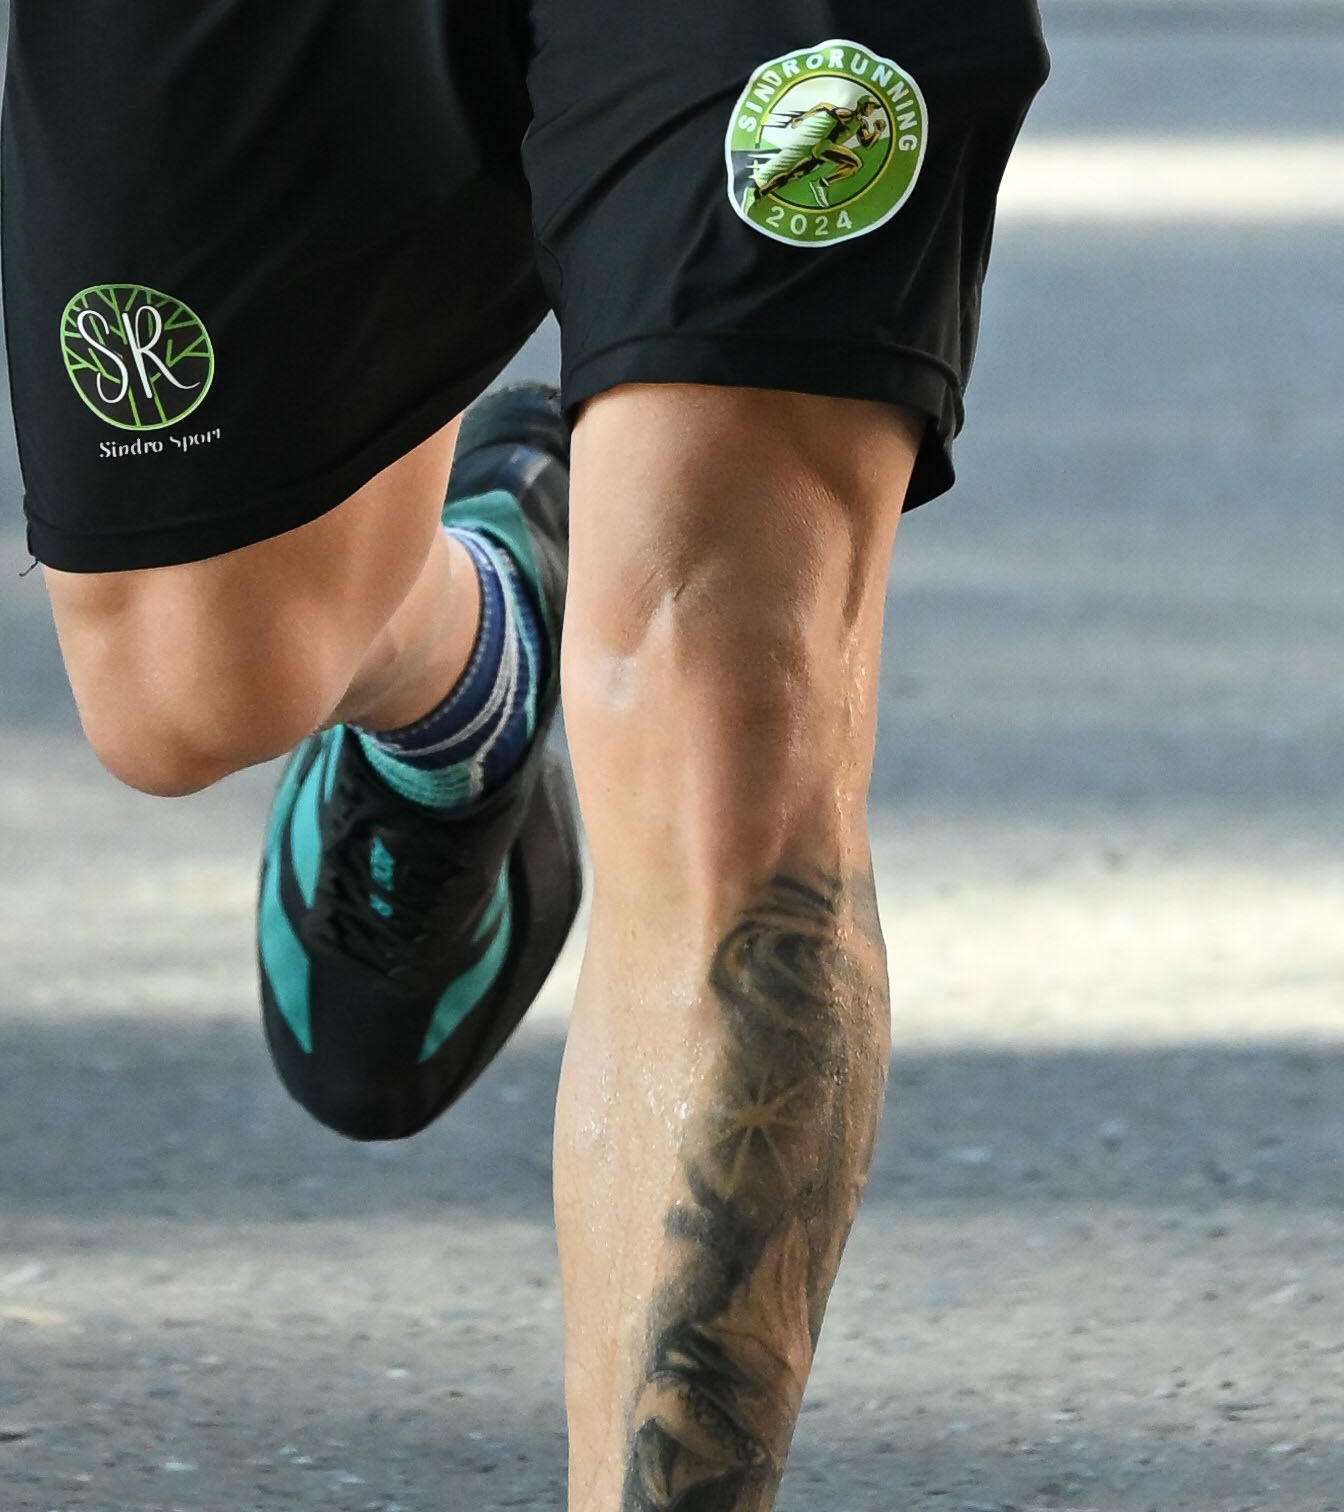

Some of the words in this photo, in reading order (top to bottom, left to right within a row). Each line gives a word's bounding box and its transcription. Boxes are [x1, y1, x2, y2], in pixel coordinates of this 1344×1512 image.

[738, 48, 918, 152] SINDRORUNNING
[765, 206, 853, 236] 2024
[76, 305, 201, 404] SR
[99, 437, 163, 458] Sindro
